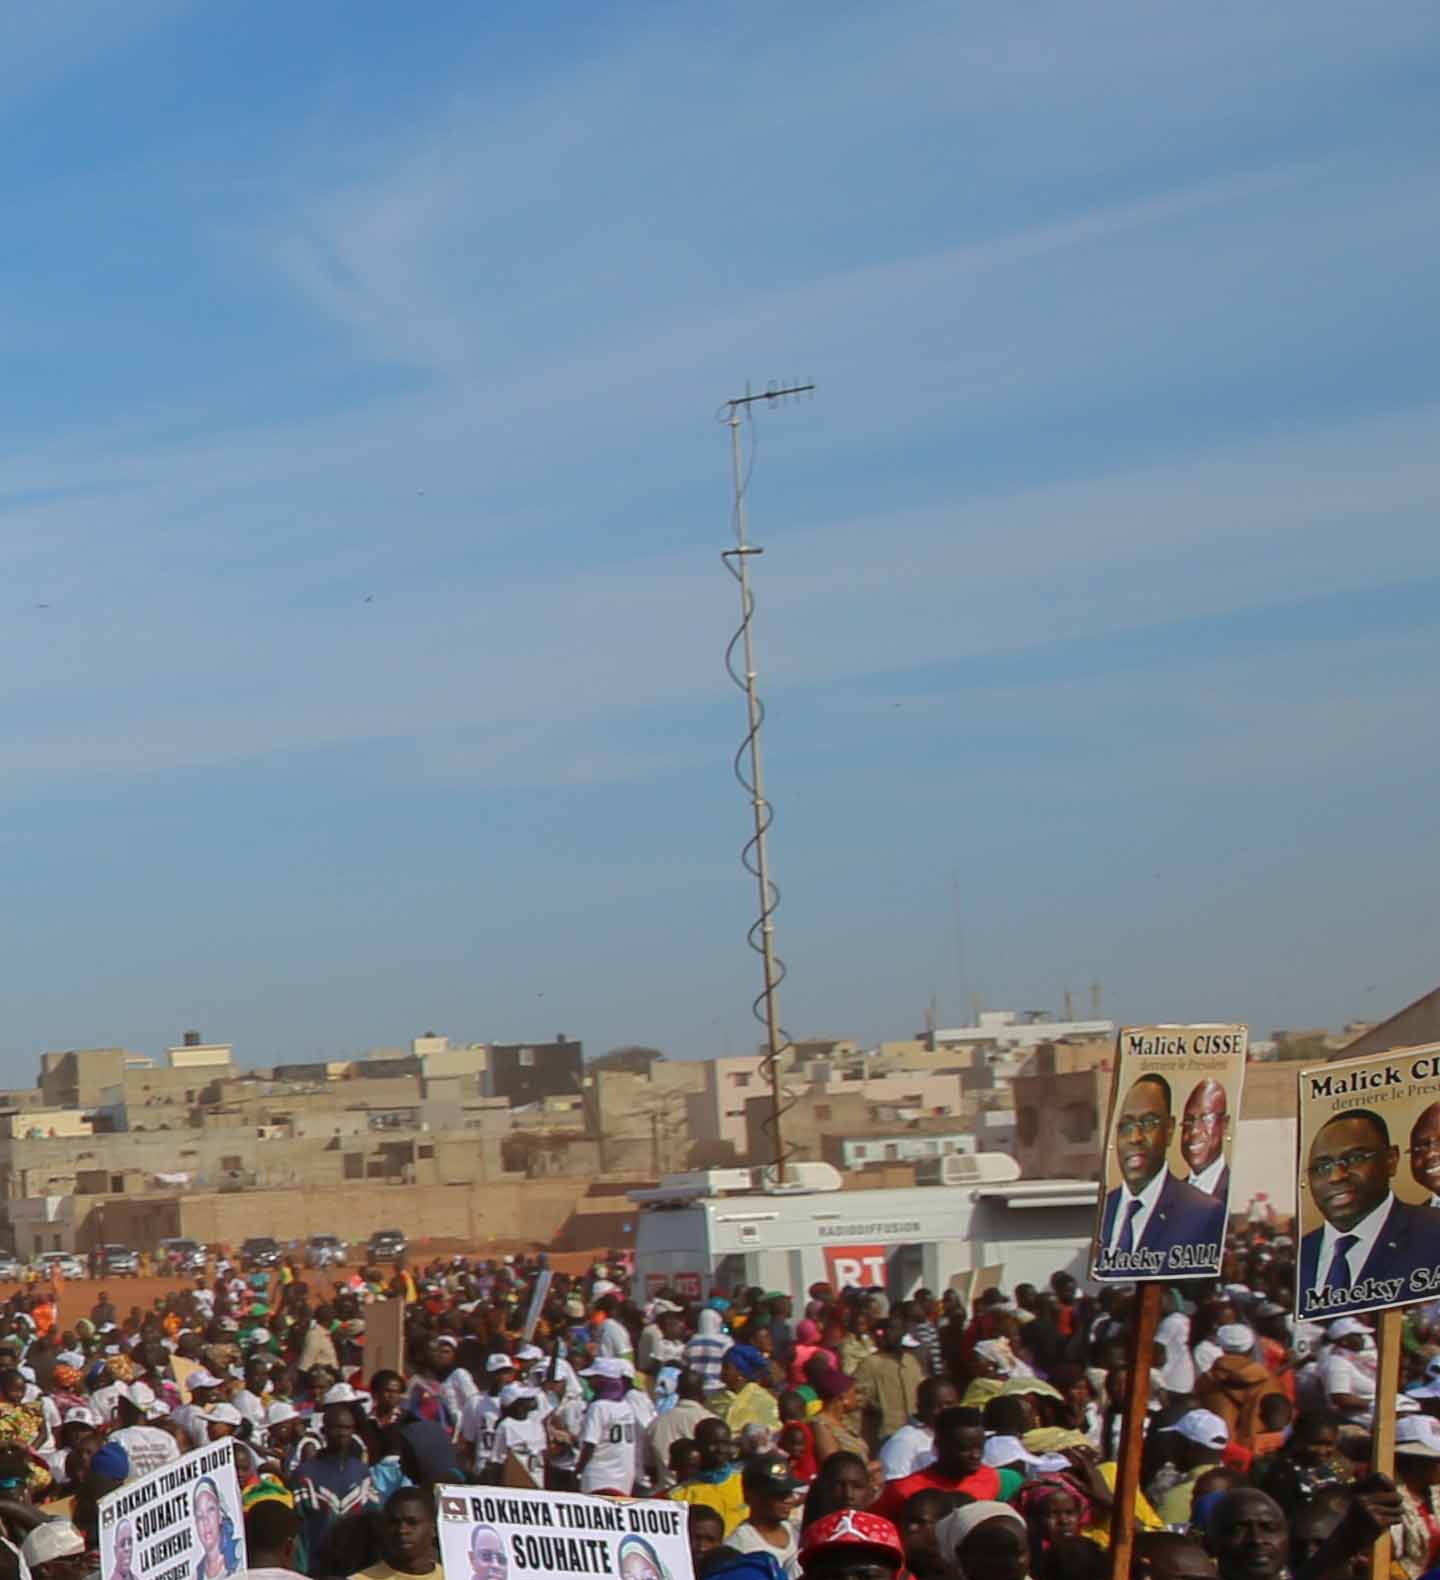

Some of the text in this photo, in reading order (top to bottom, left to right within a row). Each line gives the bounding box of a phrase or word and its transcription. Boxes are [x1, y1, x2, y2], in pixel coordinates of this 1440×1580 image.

[1129, 1035, 1242, 1055] Malick CISSE
[1311, 1066, 1401, 1100] Malick
[1100, 1244, 1219, 1274] Macky SALL
[1306, 1277, 1405, 1311] Macky
[116, 1445, 232, 1519] ROKHAYA TIDIANE DIOUF
[136, 1493, 189, 1541] SOUHAITE
[472, 1499, 679, 1535] ROKHAYA TIDIANE DIOUF
[140, 1528, 192, 1572] LA BIENVENUE
[512, 1535, 612, 1573] SOUHAITE
